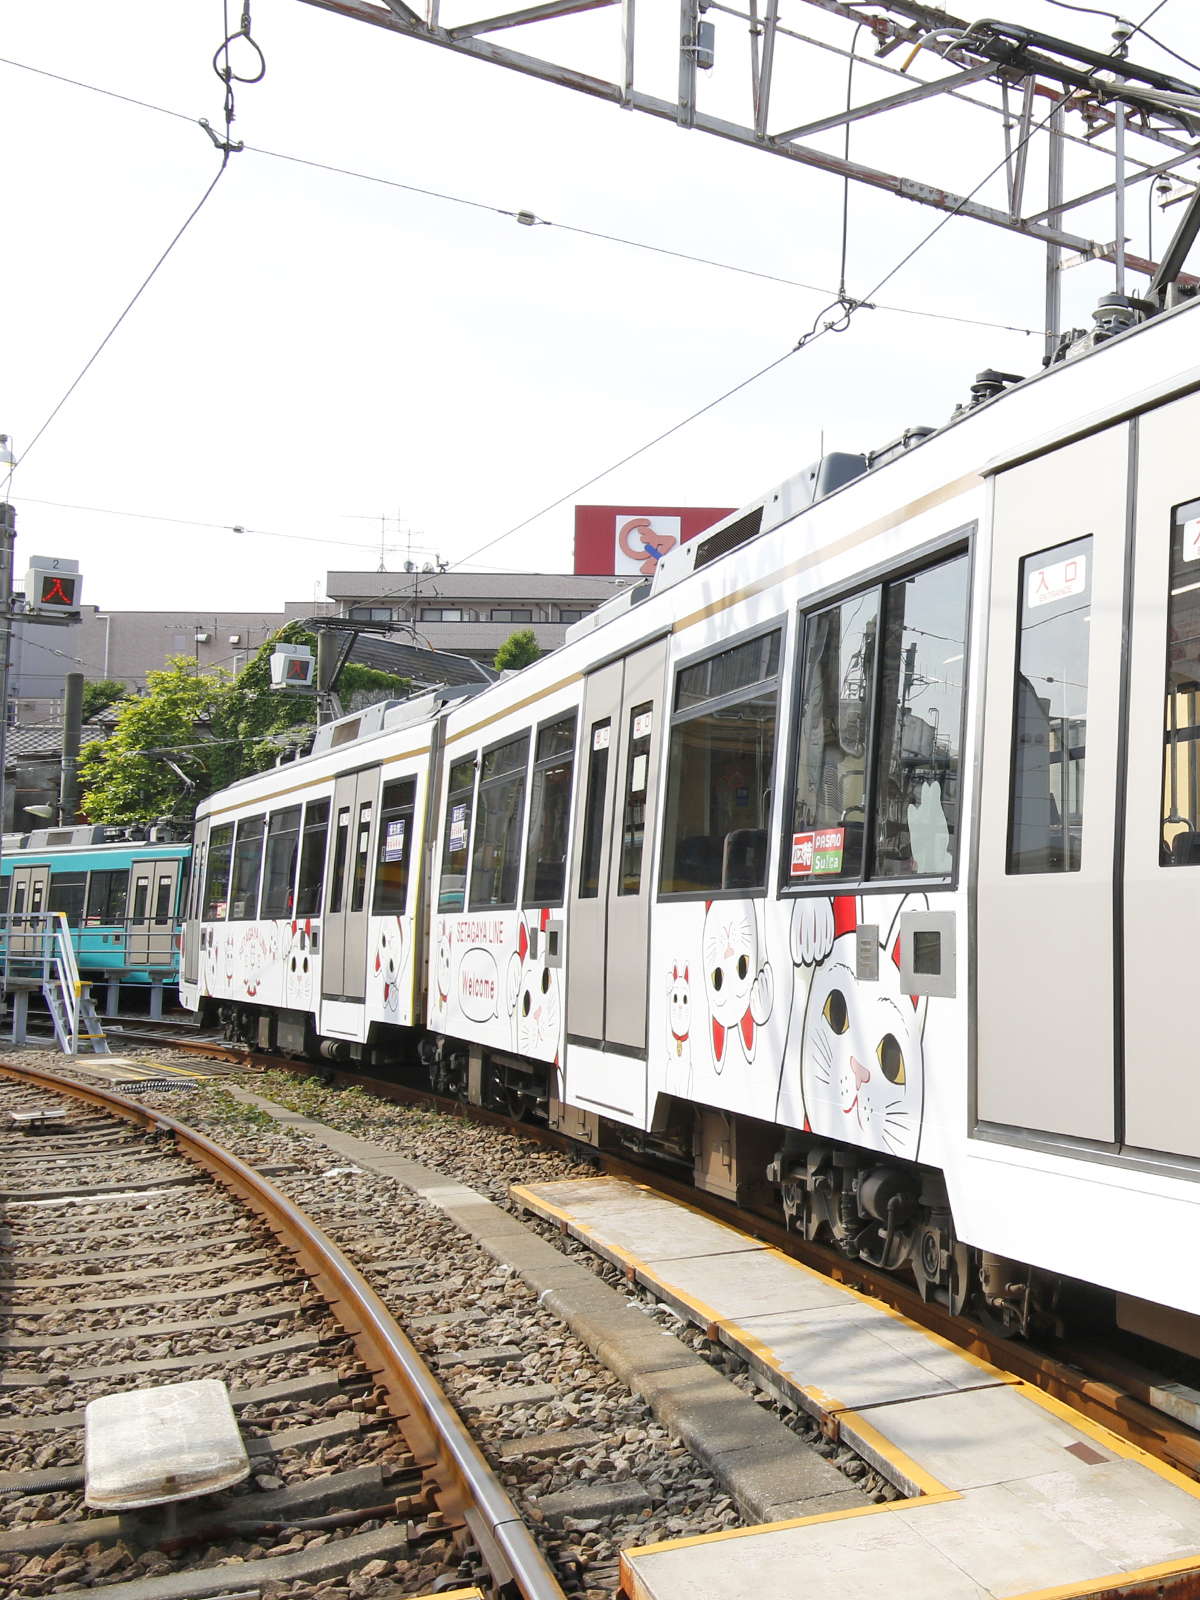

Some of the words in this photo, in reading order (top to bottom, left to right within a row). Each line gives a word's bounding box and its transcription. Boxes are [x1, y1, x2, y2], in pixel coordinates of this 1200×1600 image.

[53, 559, 60, 569] 2
[1036, 561, 1077, 592] 入口
[815, 833, 841, 849] PASMO
[815, 855, 839, 870] Suica
[457, 920, 487, 943] SETAGAYA
[489, 920, 503, 944] LINE
[463, 970, 495, 1000] Welcome
